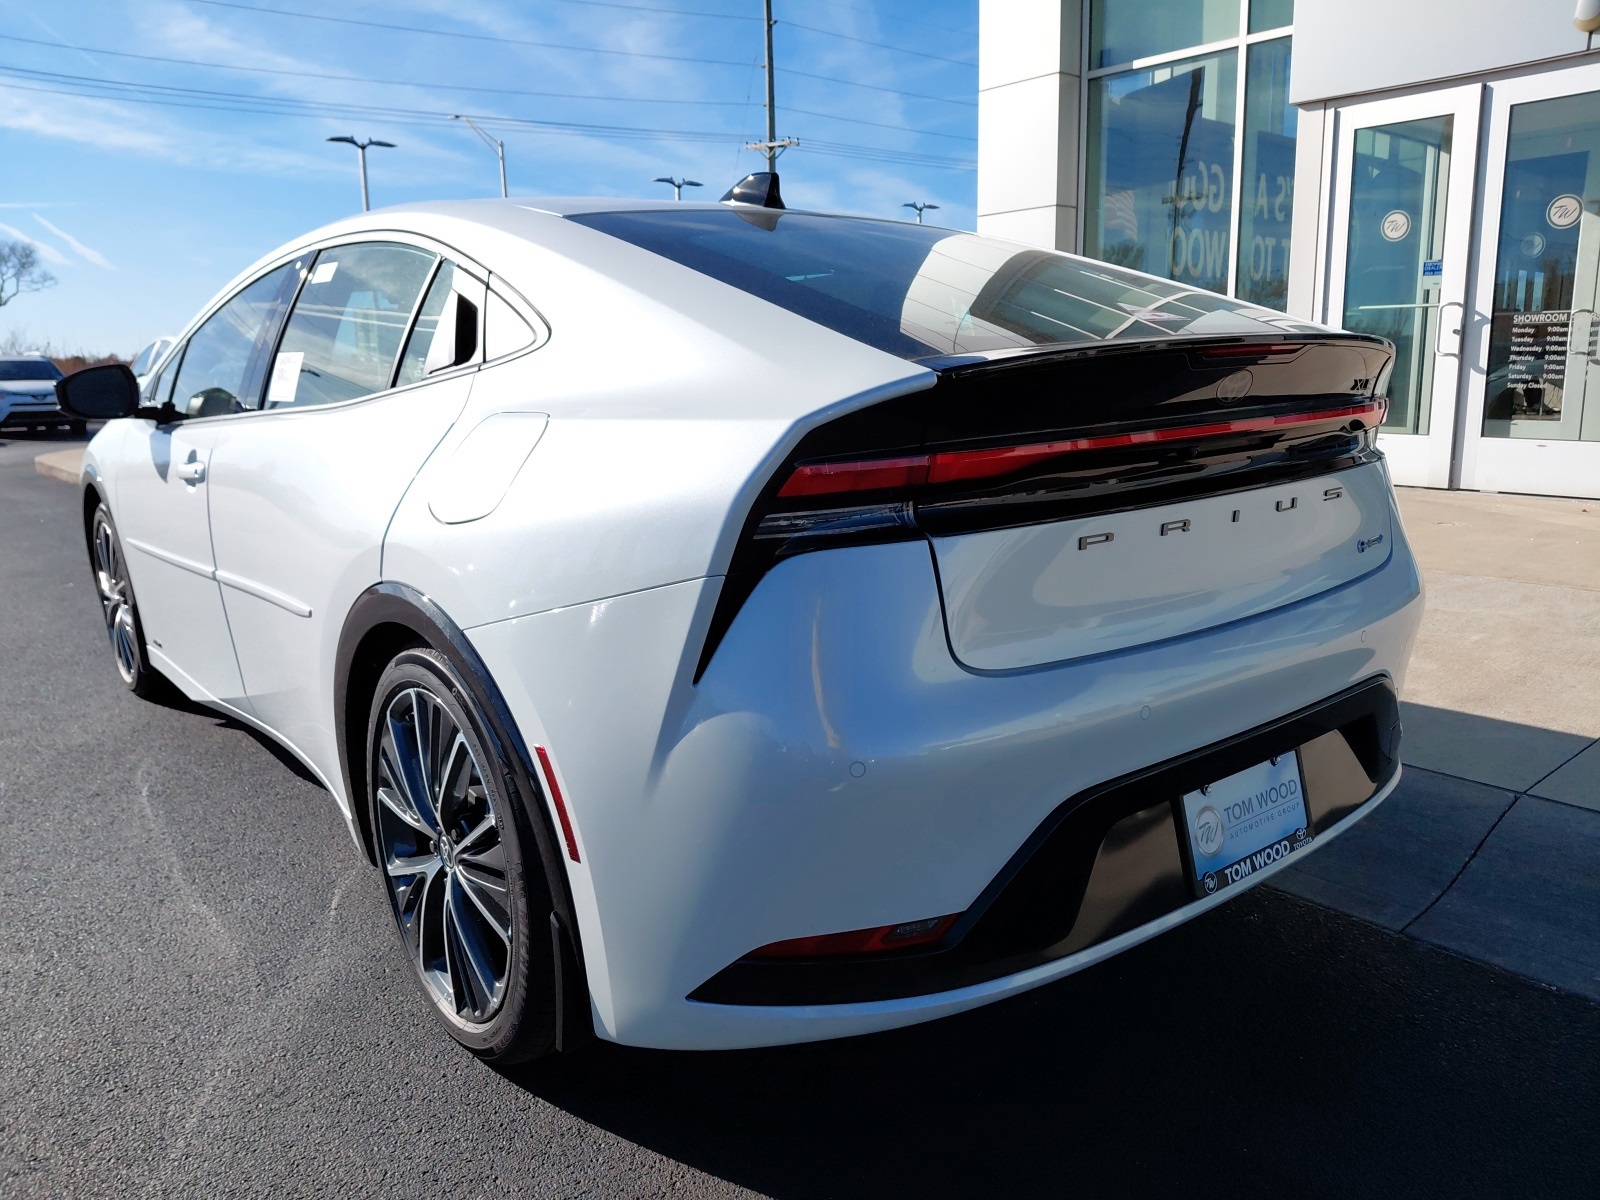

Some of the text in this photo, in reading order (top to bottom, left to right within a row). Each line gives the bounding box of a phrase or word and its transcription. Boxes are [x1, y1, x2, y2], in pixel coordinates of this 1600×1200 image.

[1513, 313, 1568, 323] SHOWROOM
[1077, 486, 1343, 551] PRIUS
[1224, 779, 1297, 823] TOM WOOD
[1230, 802, 1300, 839] AUTOMOTIVE GROUP
[1225, 840, 1290, 884] TOM WOOD
[1293, 836, 1313, 851] TOYOTA
